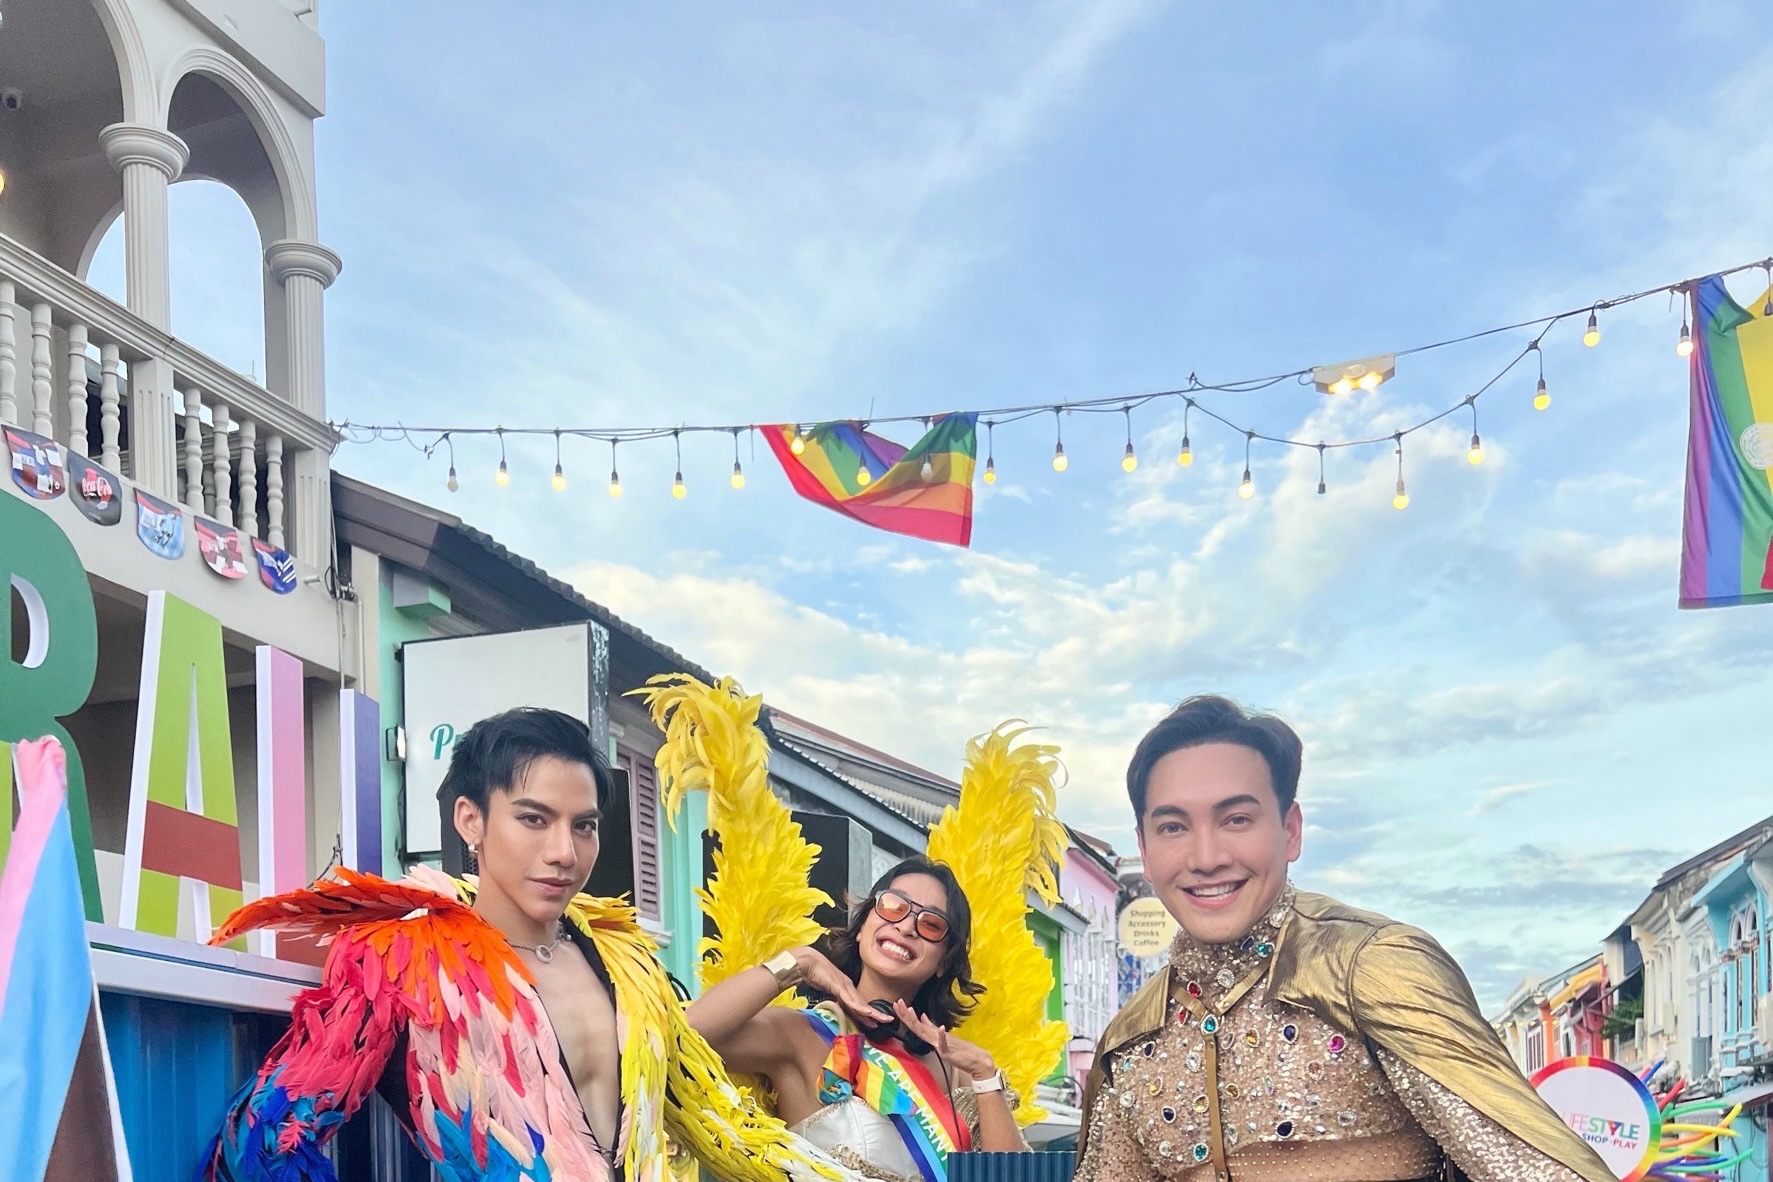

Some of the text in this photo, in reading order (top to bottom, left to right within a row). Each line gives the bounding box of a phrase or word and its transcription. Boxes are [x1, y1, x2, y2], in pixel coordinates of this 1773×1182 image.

[429, 723, 464, 760] P
[1130, 910, 1166, 918] Shopping
[1128, 920, 1166, 928] Accessory
[1613, 1138, 1637, 1150] PLAY
